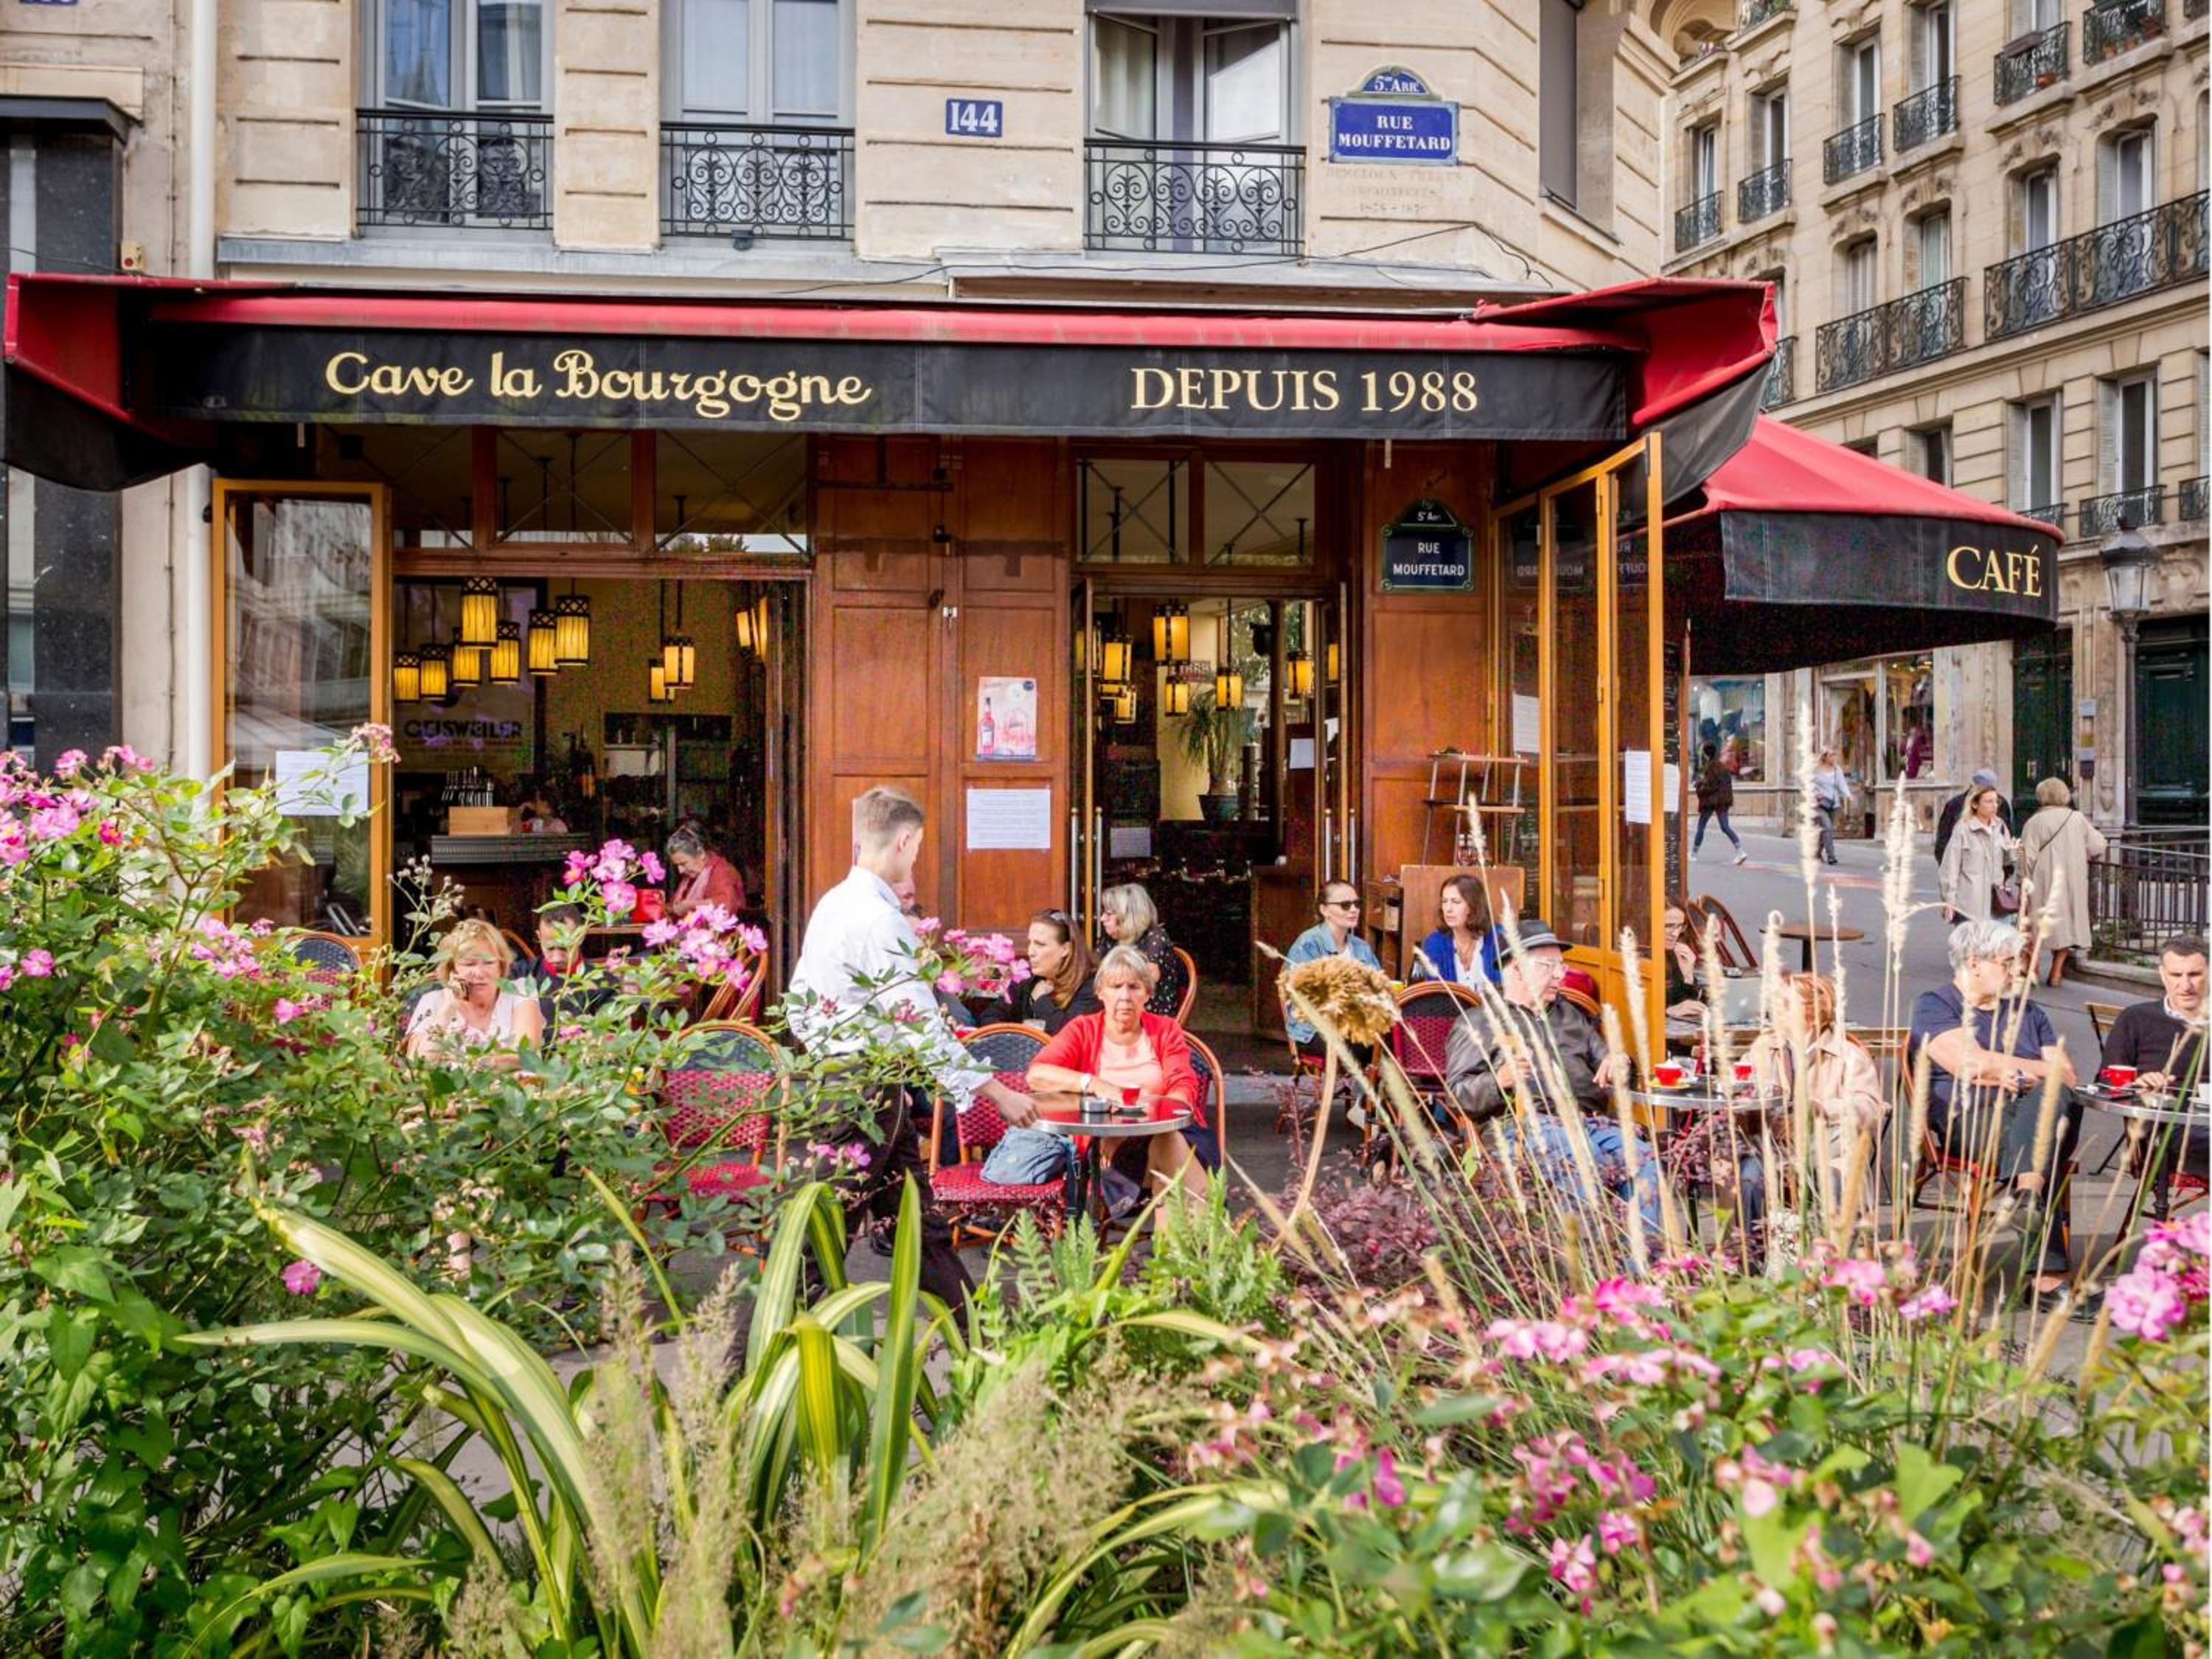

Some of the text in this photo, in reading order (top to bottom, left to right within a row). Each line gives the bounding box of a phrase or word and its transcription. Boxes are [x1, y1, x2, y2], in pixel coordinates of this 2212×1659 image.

[950, 102, 998, 132] 144
[1377, 115, 1413, 130] RUE
[1338, 133, 1450, 150] MOUFFETARD
[325, 349, 872, 422] Cave la Bourgogne
[1130, 367, 1478, 413] DEPUIS 1988
[1418, 543, 1440, 554] RUE
[1393, 564, 1465, 576] MOUFFETARD
[1947, 544, 2042, 597] CAFÉ
[404, 720, 522, 738] GEISWEILER
